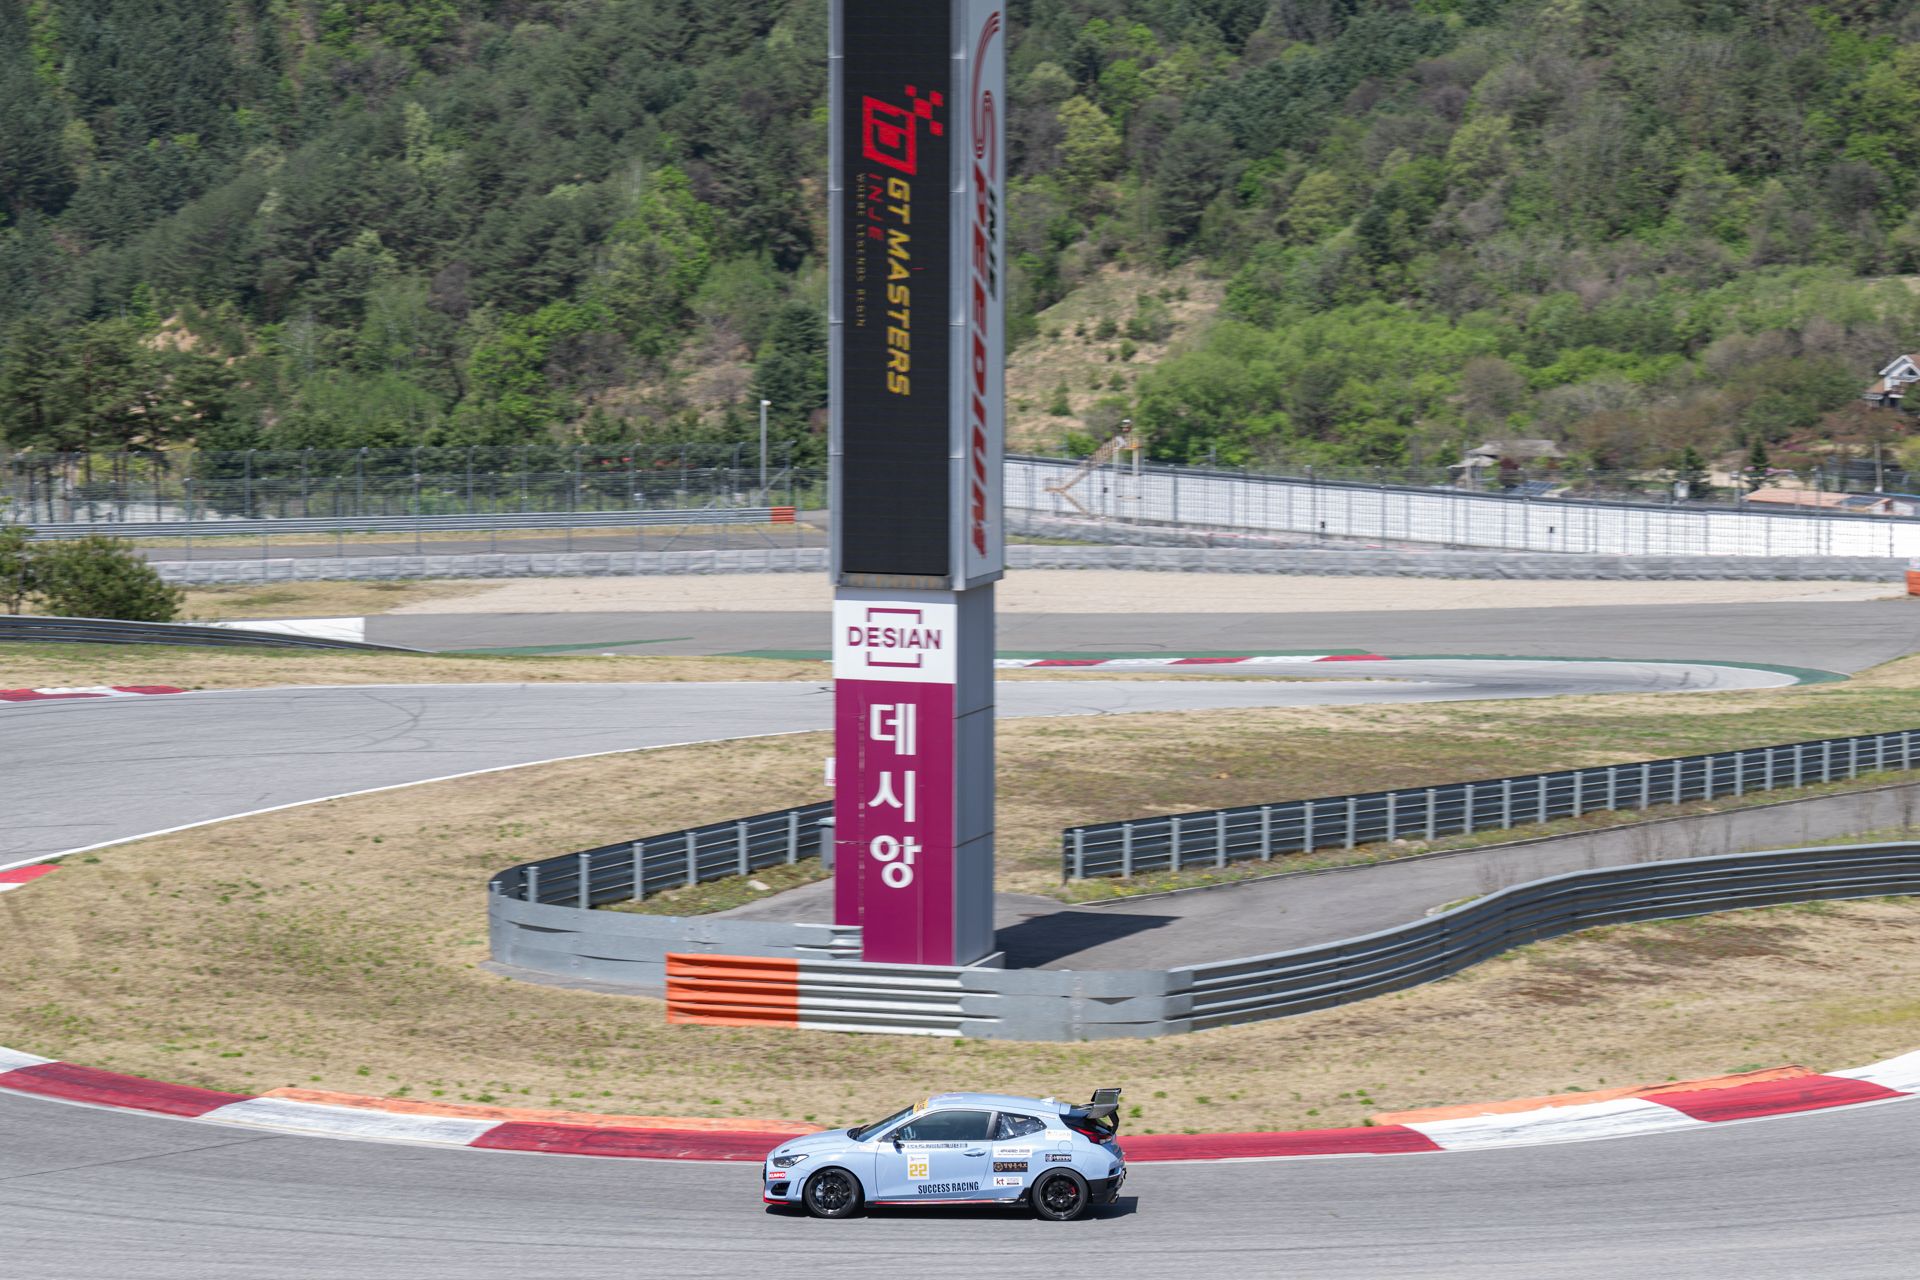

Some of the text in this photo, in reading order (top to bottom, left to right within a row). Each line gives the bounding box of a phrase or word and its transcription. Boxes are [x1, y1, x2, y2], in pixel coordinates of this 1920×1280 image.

[855, 172, 866, 217] WHERE
[867, 173, 884, 241] INJE
[887, 176, 911, 396] GT MASTERS
[847, 626, 942, 650] DESIAN
[867, 702, 922, 889] 데시앙
[909, 1163, 928, 1177] 22
[995, 1177, 1005, 1186] kt
[917, 1181, 980, 1194] SUCCESS RACING
